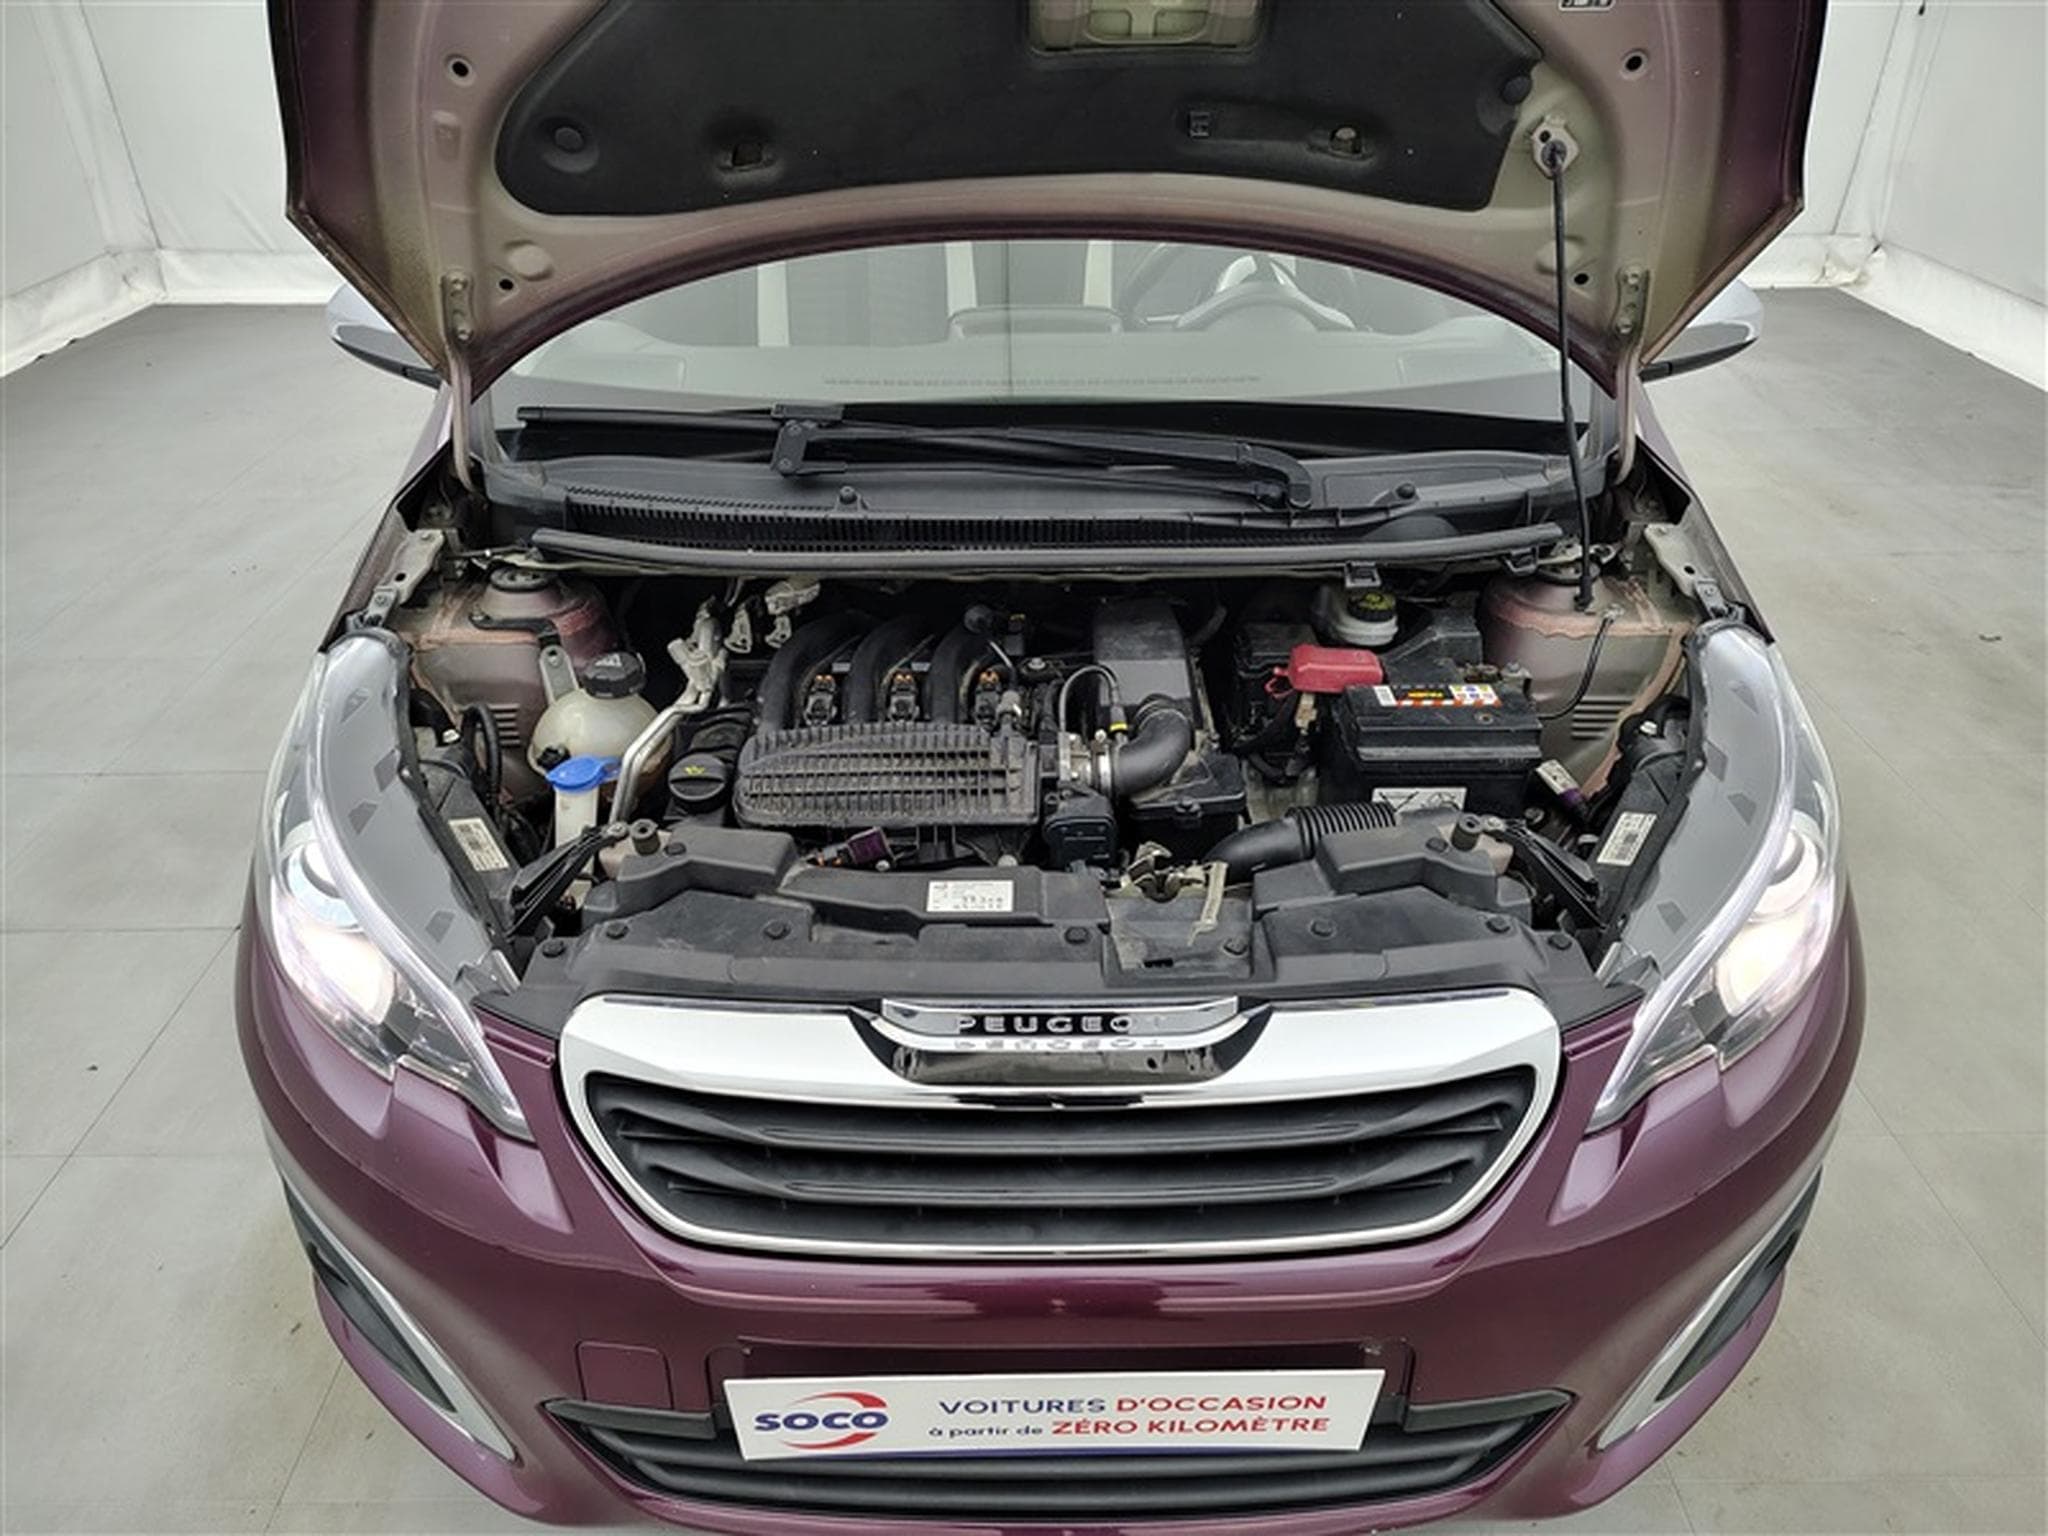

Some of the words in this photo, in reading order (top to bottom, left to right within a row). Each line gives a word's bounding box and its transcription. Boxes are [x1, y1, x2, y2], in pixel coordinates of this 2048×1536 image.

[939, 1398, 1106, 1414] VOITURES
[1116, 1396, 1328, 1412] D'OCCASION
[754, 1411, 889, 1432] SOCO
[950, 1425, 1010, 1439] partir
[1016, 1425, 1044, 1435] de
[1052, 1417, 1139, 1435] ZÉRO
[1148, 1416, 1331, 1433] KILOMÈTRE
